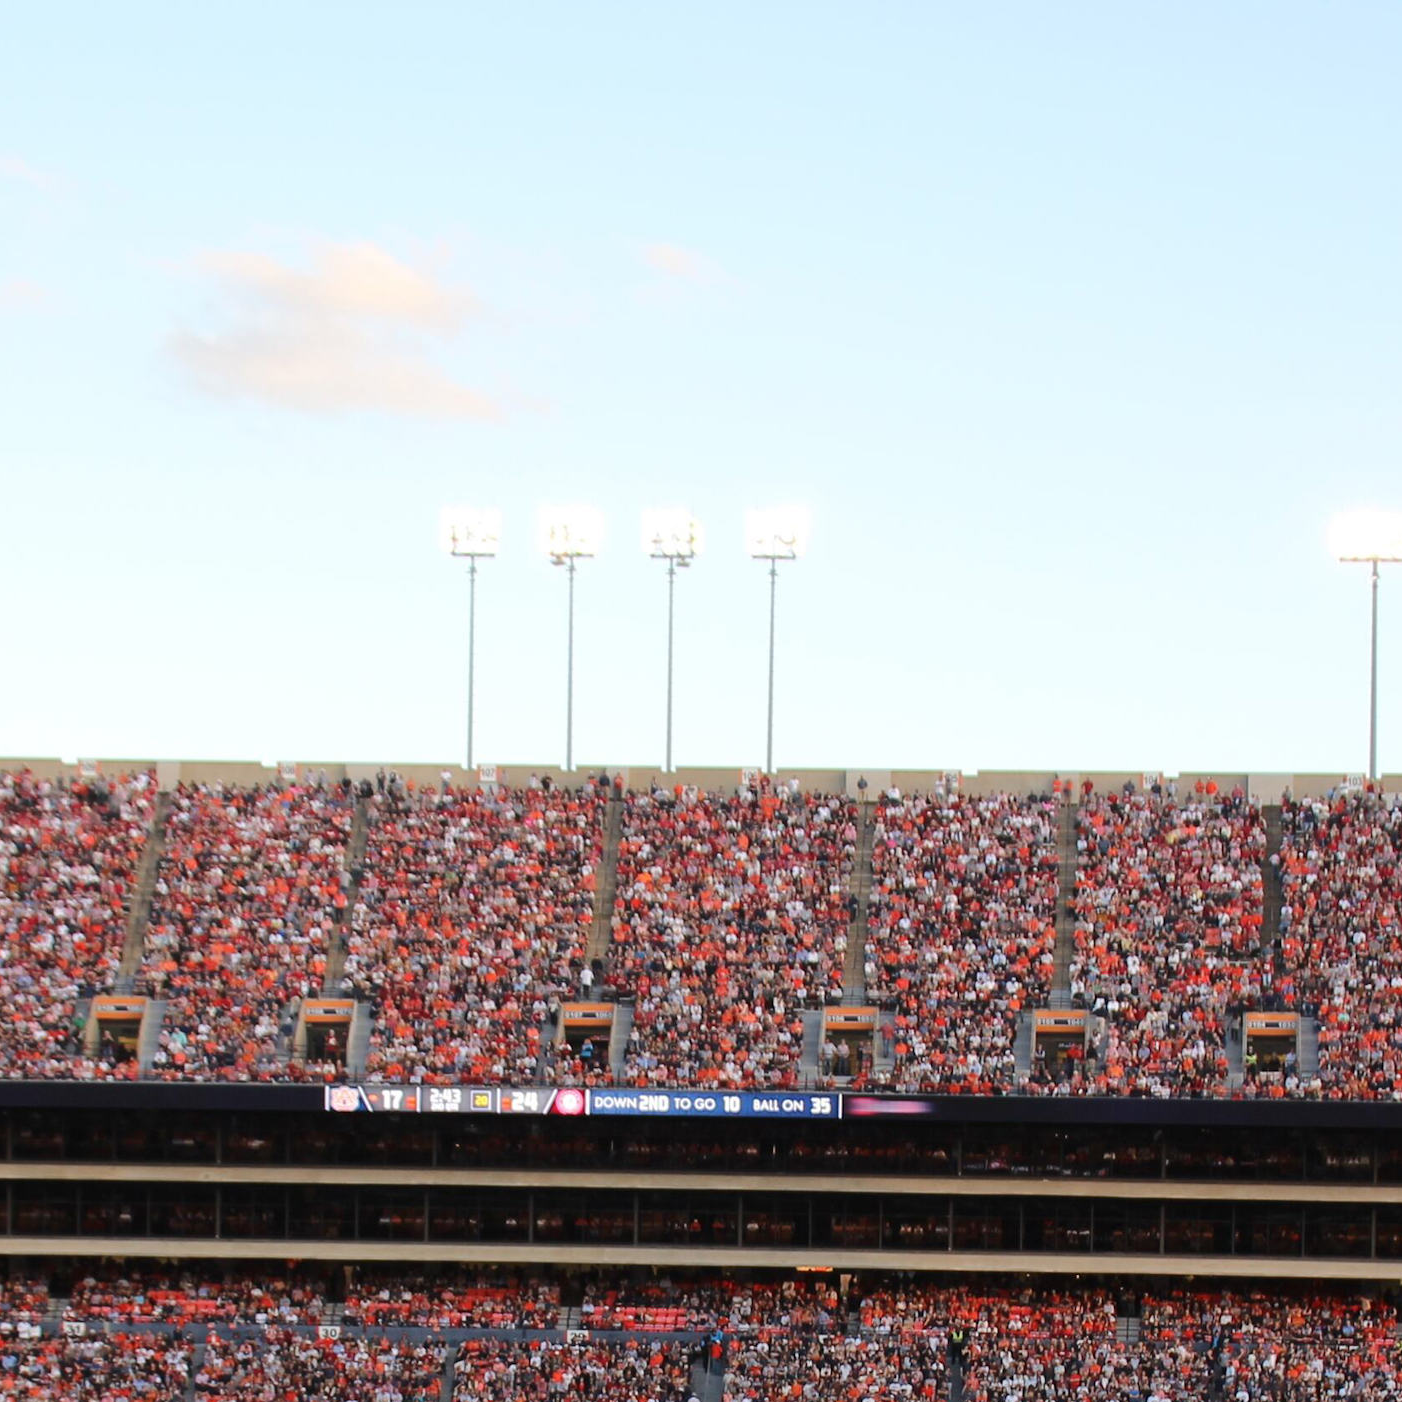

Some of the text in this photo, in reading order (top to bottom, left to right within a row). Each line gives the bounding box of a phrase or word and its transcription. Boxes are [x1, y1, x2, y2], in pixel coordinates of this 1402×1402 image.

[381, 1090, 403, 1110] 17
[429, 1088, 462, 1104] 2:43
[474, 1094, 488, 1106] 20
[511, 1092, 539, 1111] 24
[594, 1095, 832, 1114] DOWN 2ND TO GO 10 BALL ON 35
